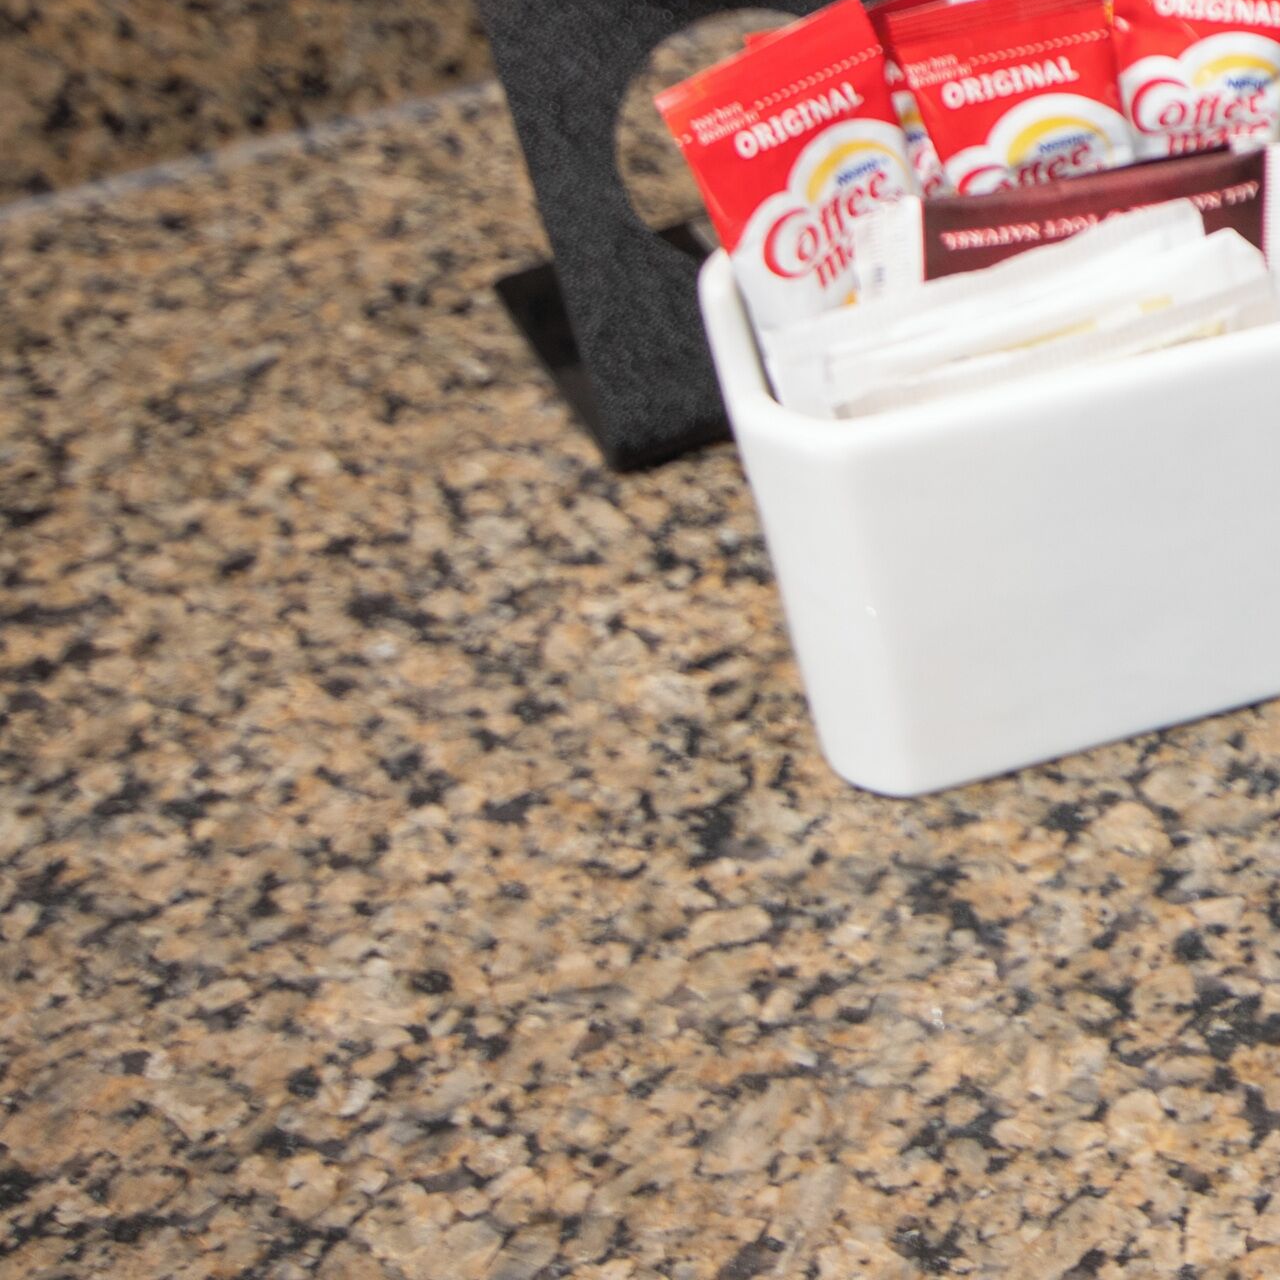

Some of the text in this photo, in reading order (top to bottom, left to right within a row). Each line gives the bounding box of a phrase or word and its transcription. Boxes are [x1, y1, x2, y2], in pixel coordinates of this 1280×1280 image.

[733, 81, 865, 159] ORIGINAL
[940, 55, 1080, 110] ORIGINAL
[763, 171, 887, 279] Coffee
